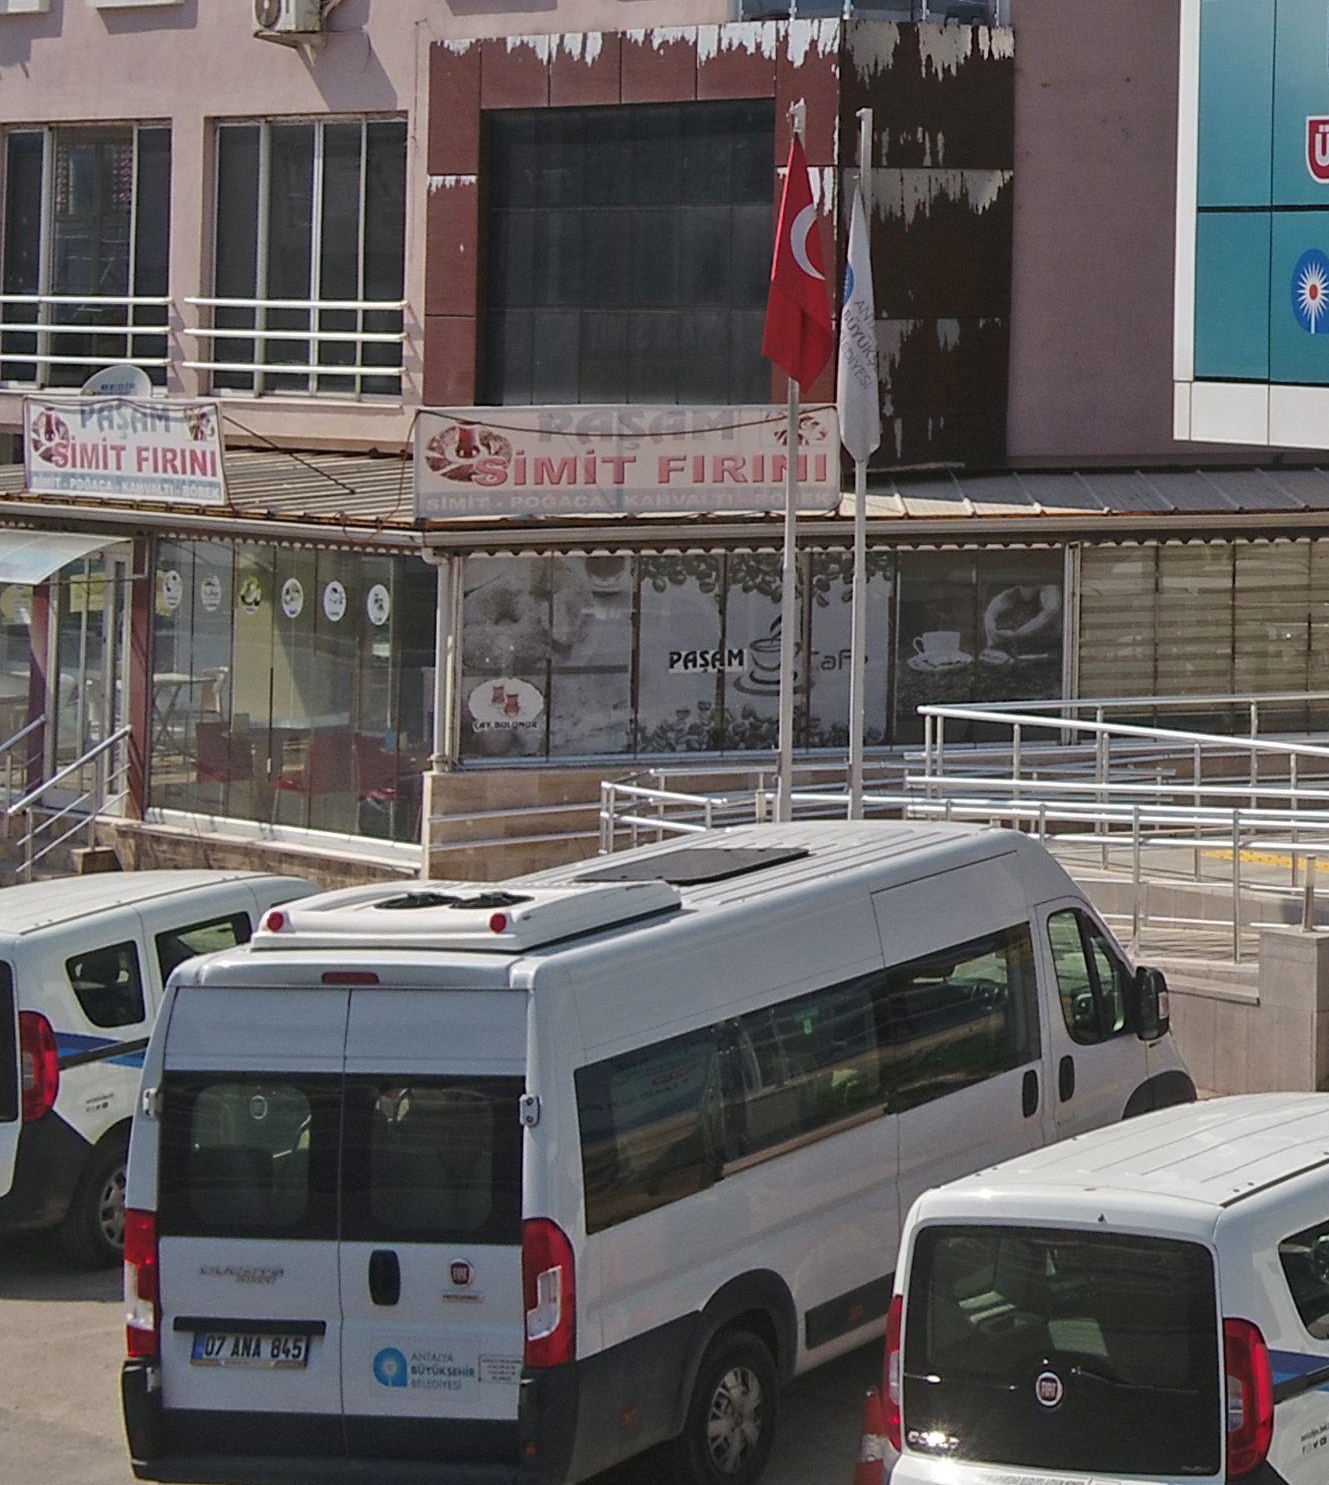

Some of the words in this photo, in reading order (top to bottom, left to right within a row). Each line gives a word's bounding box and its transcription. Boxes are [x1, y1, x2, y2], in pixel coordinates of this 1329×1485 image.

[80, 402, 171, 440] PAŞAM
[537, 408, 736, 450] PAŞAM
[52, 434, 127, 471] SİMİT
[136, 445, 217, 477] FIRINI
[472, 449, 637, 487] SİMİT
[669, 648, 745, 673] PAŞAM
[204, 1335, 227, 1357] 07
[230, 1337, 262, 1358] ANA
[270, 1337, 303, 1359] 845
